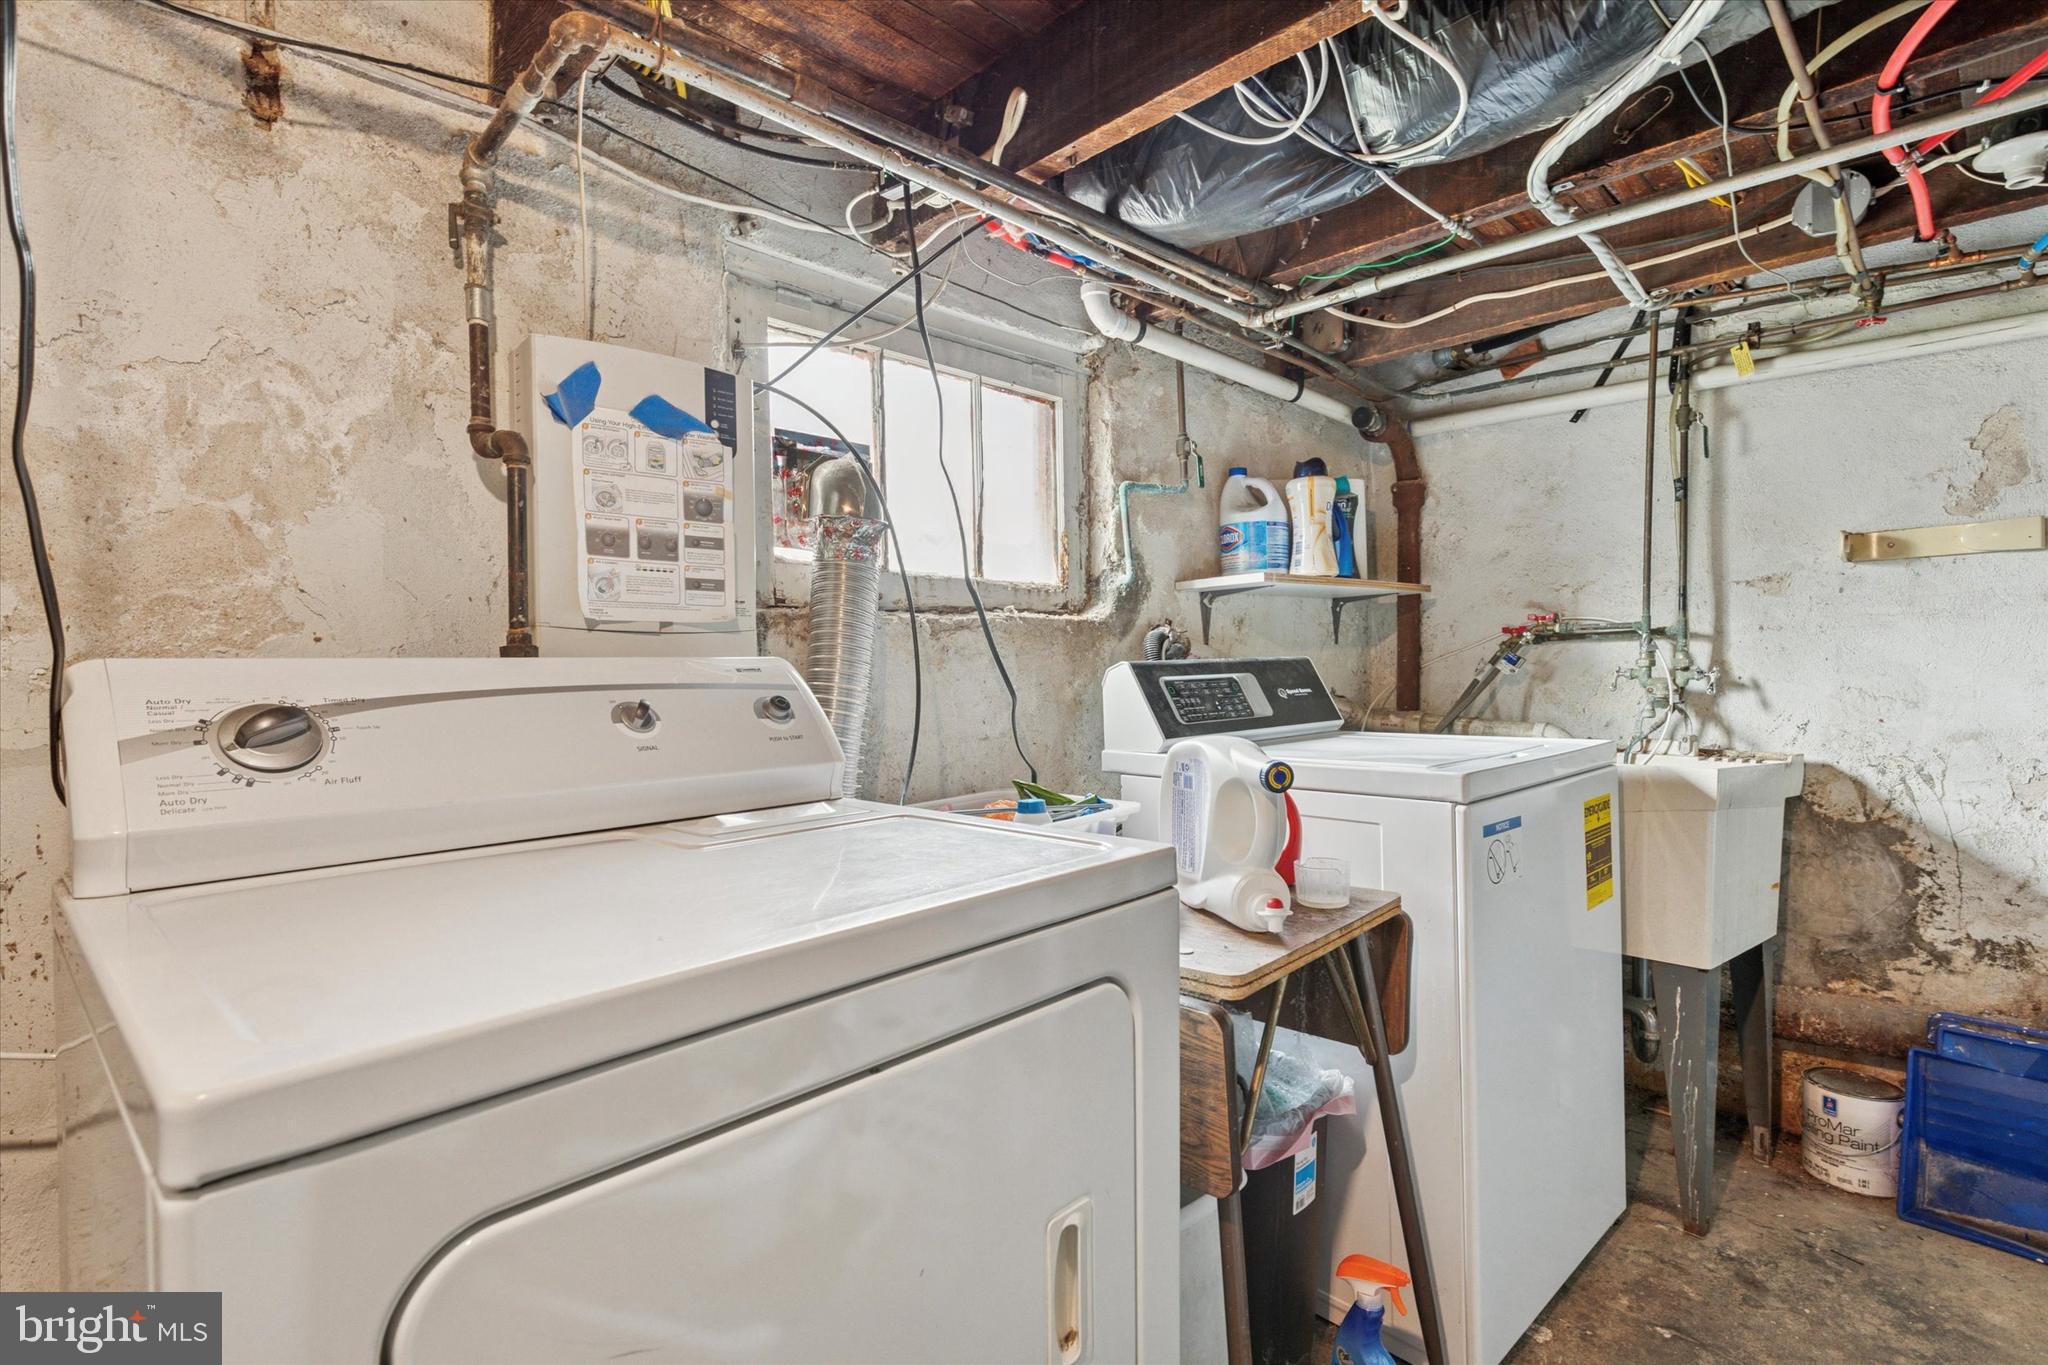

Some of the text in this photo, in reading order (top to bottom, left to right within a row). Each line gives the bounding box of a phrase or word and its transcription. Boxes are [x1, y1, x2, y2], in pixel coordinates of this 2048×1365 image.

[589, 416, 606, 425] Using
[608, 419, 621, 427] Your
[341, 776, 361, 784] Fluff
[160, 797, 207, 807] Auto Dry
[160, 807, 197, 816] Delicate
[1807, 1109, 1862, 1137] ProMar
[1838, 1134, 1880, 1152] Paint
